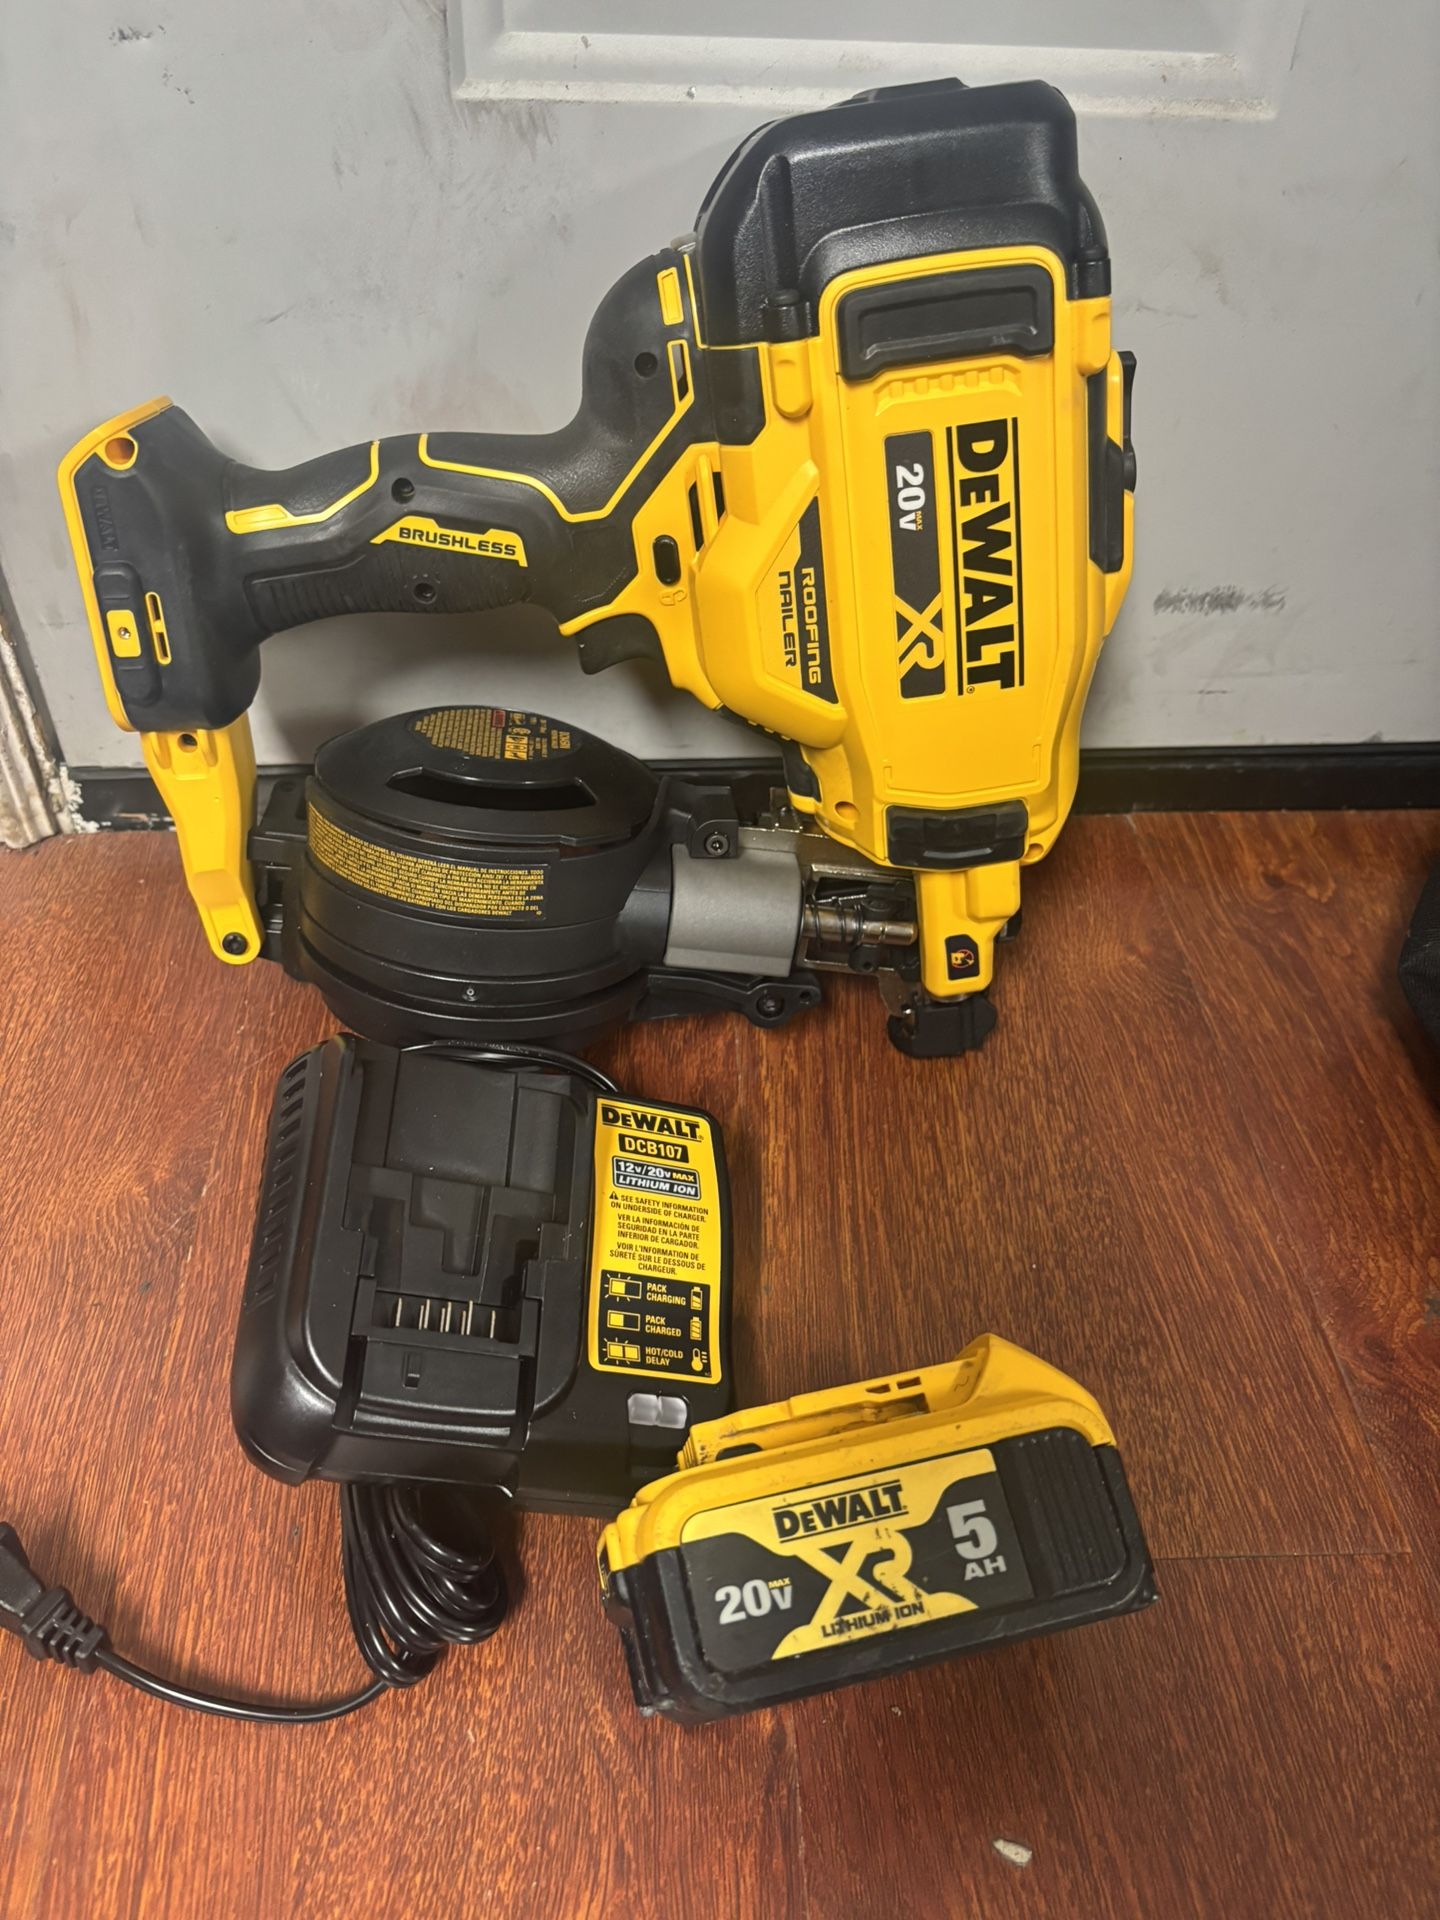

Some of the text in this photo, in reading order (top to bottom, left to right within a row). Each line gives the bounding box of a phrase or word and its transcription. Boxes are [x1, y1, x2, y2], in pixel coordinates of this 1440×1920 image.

[399, 527, 516, 556] BRUSHLESS
[956, 418, 1015, 689] DEWALT
[778, 571, 797, 667] NAILER
[801, 567, 822, 684] ROOFING
[893, 592, 945, 679] XR
[602, 1107, 700, 1139] DEWALT
[624, 1137, 682, 1159] DCB107
[619, 1175, 696, 1196] LITHIUM ION
[672, 1172, 695, 1182] MAX
[611, 1201, 621, 1209] ON
[622, 1202, 662, 1215] UNDERSIDE
[673, 1211, 707, 1223] CHARGER.
[621, 1195, 709, 1215] SEE SAFETY INFORMATION
[617, 1213, 631, 1221] VER
[632, 1215, 641, 1223] LA
[642, 1217, 690, 1231] INFORMACIÓN
[617, 1222, 700, 1241] SEGURIDAD EN LA PARTE
[617, 1230, 700, 1249] INFERIOR DE CARGADOR.
[616, 1242, 699, 1261] VOIR L'INFORMATION DE
[638, 1254, 652, 1262] SUR
[653, 1256, 662, 1264] LE
[663, 1257, 695, 1269] DESSOUS
[696, 1263, 706, 1271] DE
[638, 1263, 678, 1275] CHARGEUR.
[646, 1282, 667, 1293] PACK
[646, 1293, 686, 1306] CHARGING
[645, 1315, 666, 1325] PACK
[645, 1325, 681, 1337] CHARGED
[645, 1347, 684, 1359] HOT/COLD
[645, 1356, 670, 1366] DELAY
[773, 1484, 904, 1539] DEWALT
[946, 1499, 997, 1560] 5
[795, 1531, 931, 1625] XR
[964, 1555, 1007, 1581] AH
[768, 1577, 790, 1589] MAX
[820, 1601, 925, 1638] LITHIUM ION
